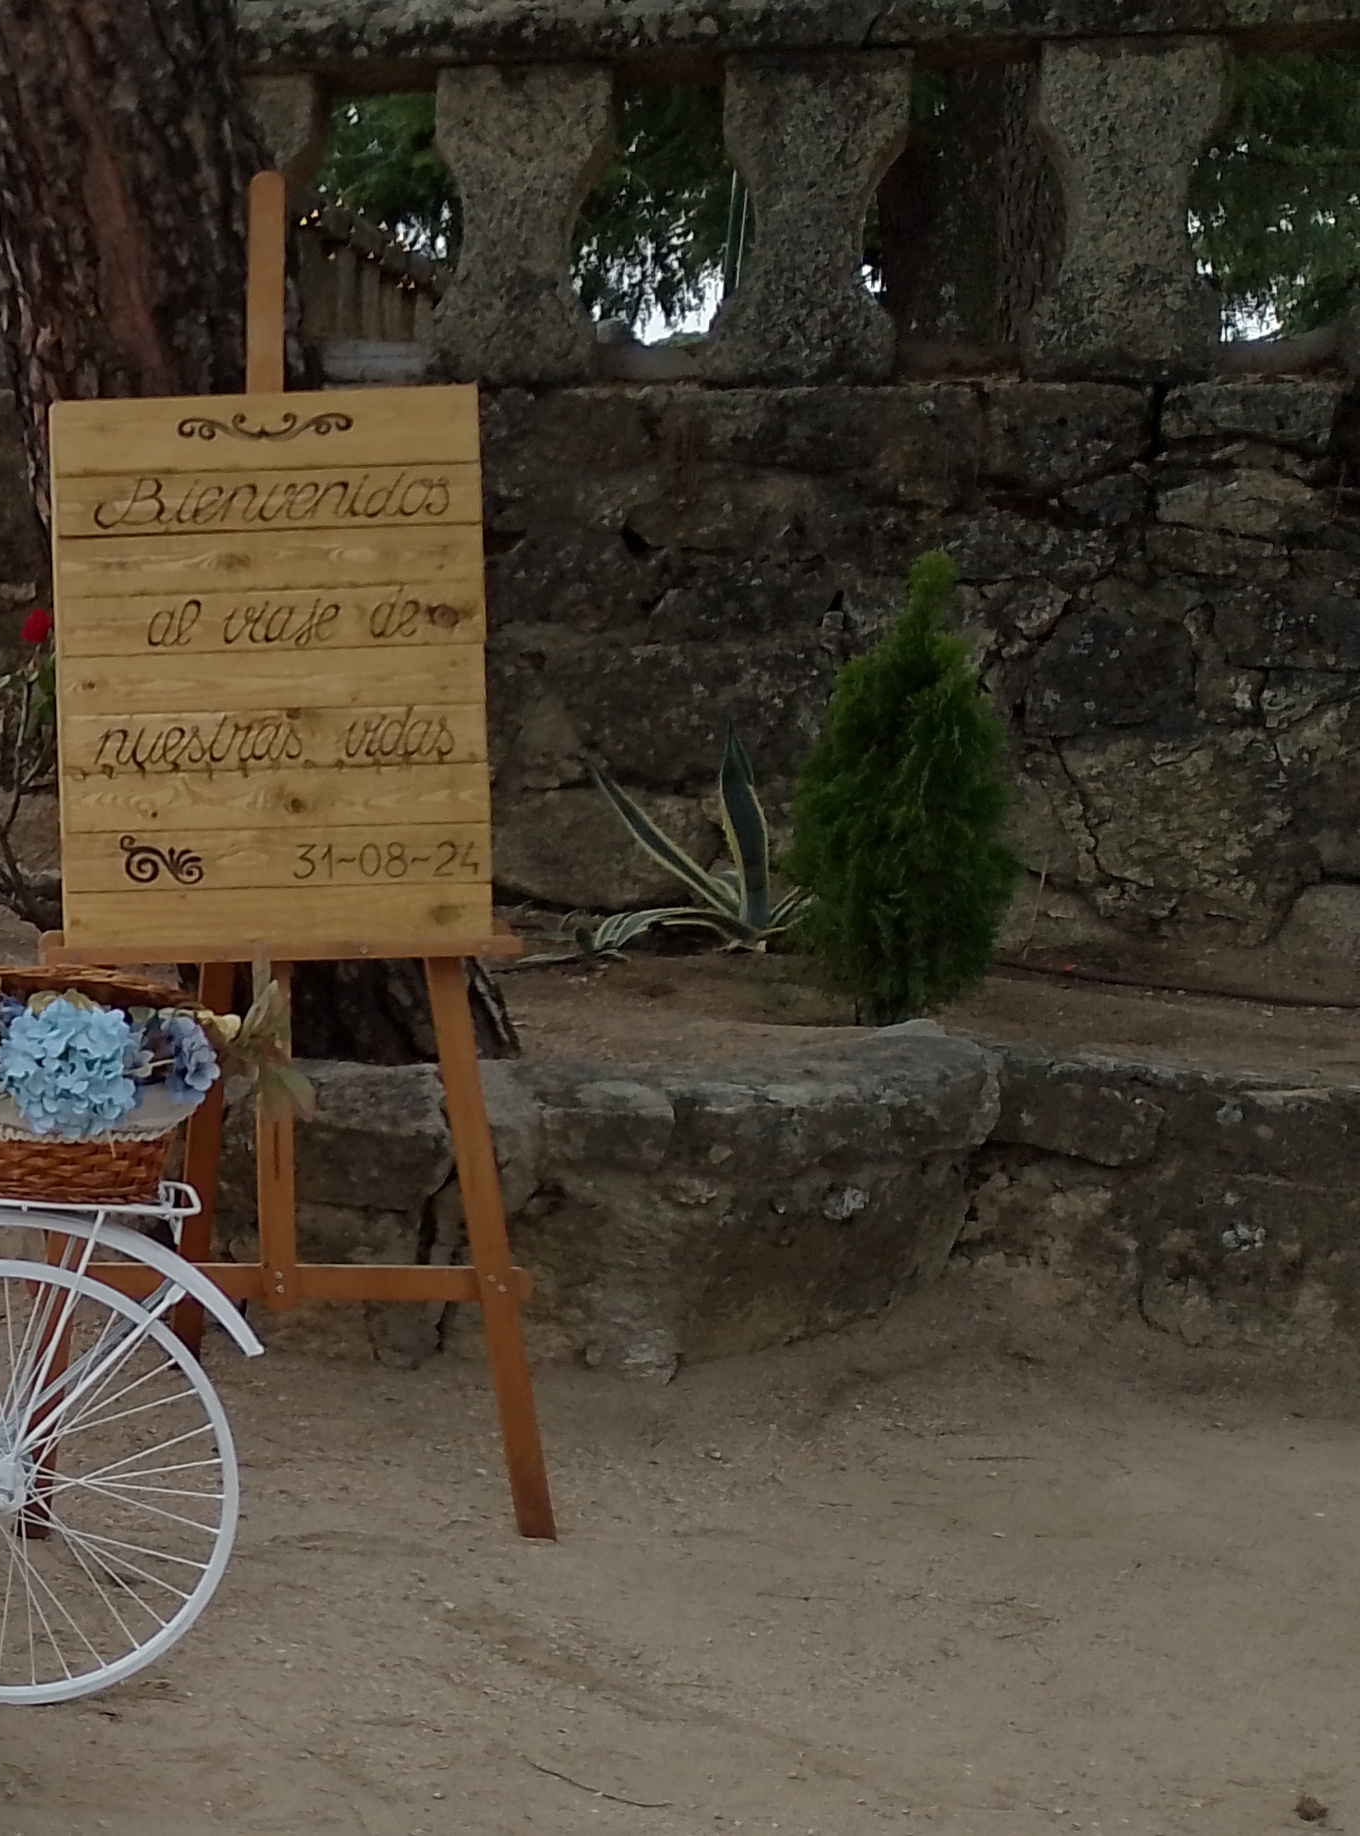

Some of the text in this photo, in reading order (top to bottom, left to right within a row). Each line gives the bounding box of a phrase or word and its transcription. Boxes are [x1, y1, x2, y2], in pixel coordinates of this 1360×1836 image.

[93, 472, 451, 531] Bienvenidos
[147, 585, 419, 647] al viaje de
[93, 705, 455, 766] nuestras vidas
